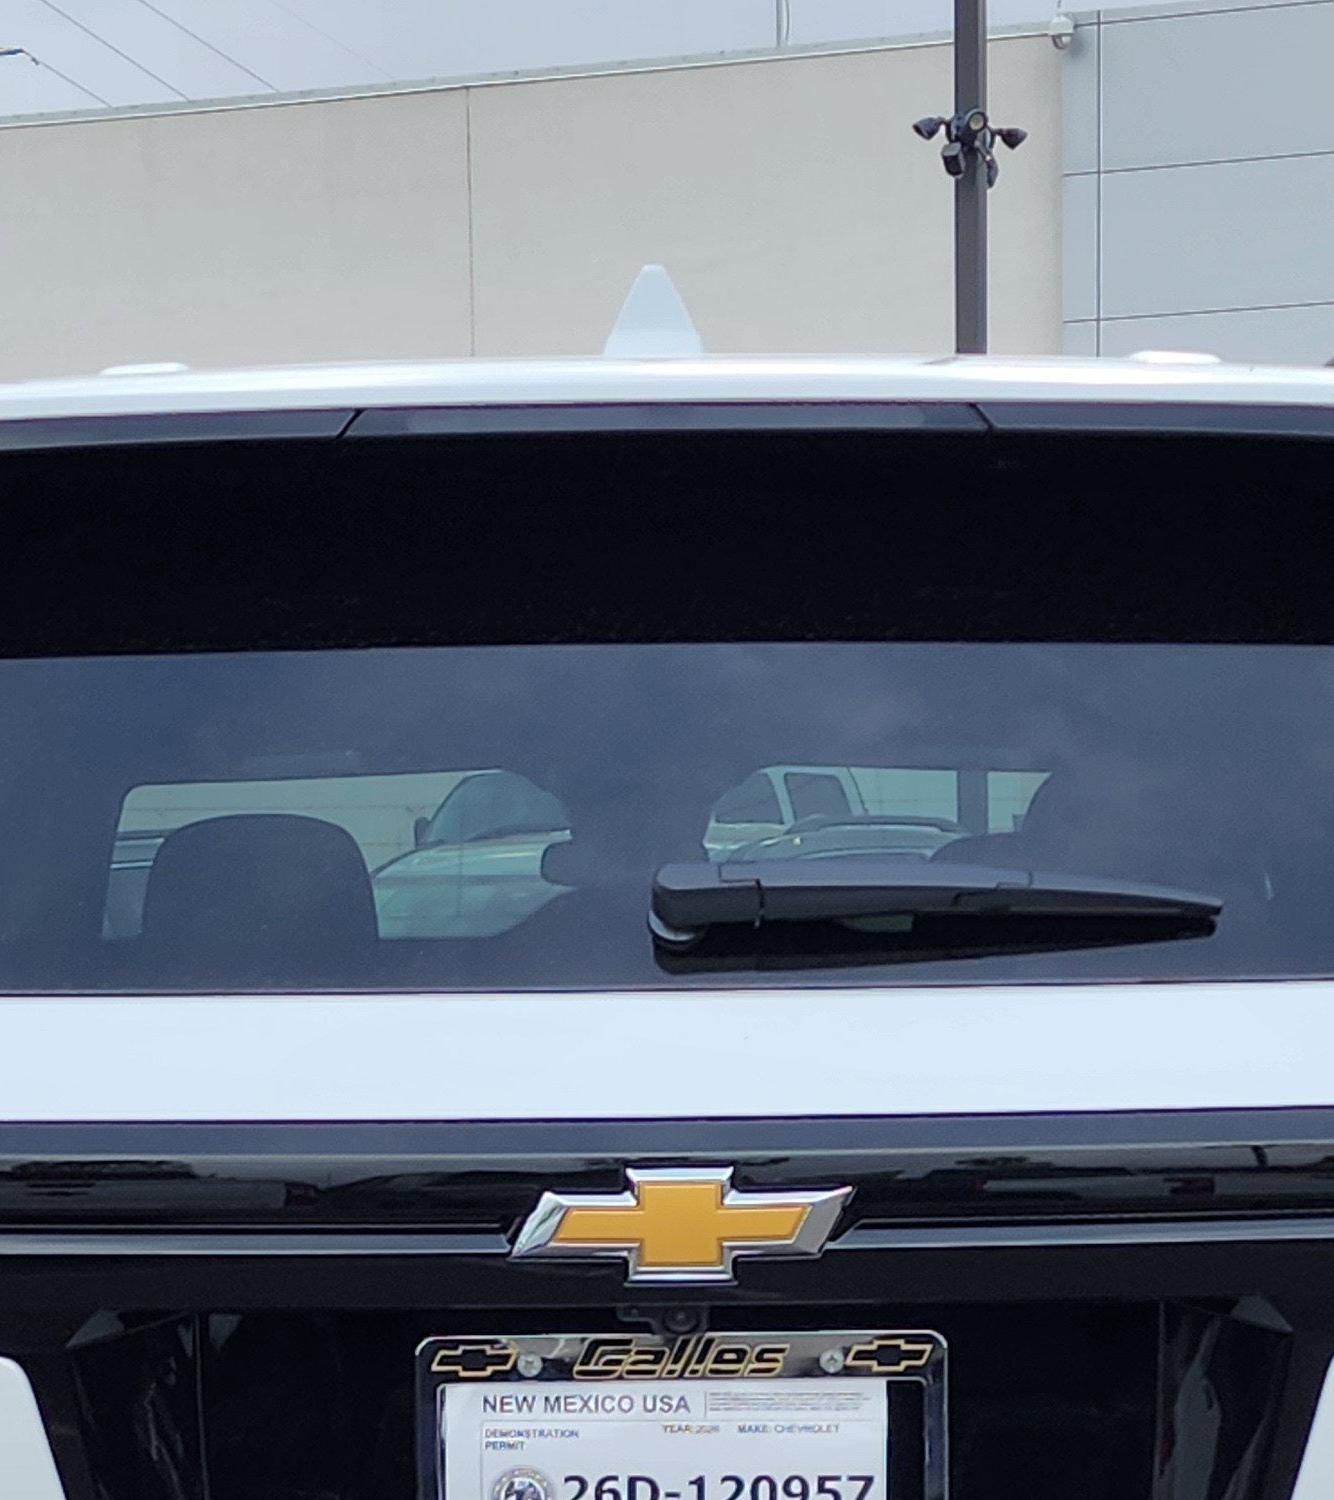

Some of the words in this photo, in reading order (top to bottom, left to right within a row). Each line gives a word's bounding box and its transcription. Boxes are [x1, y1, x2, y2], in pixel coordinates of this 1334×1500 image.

[573, 1335, 790, 1379] Galles
[482, 1395, 534, 1413] NEW
[543, 1395, 634, 1413] MEXICO
[642, 1395, 691, 1413] USA
[485, 1428, 579, 1438] DEMONSTRATION
[485, 1441, 525, 1450] PERMIT
